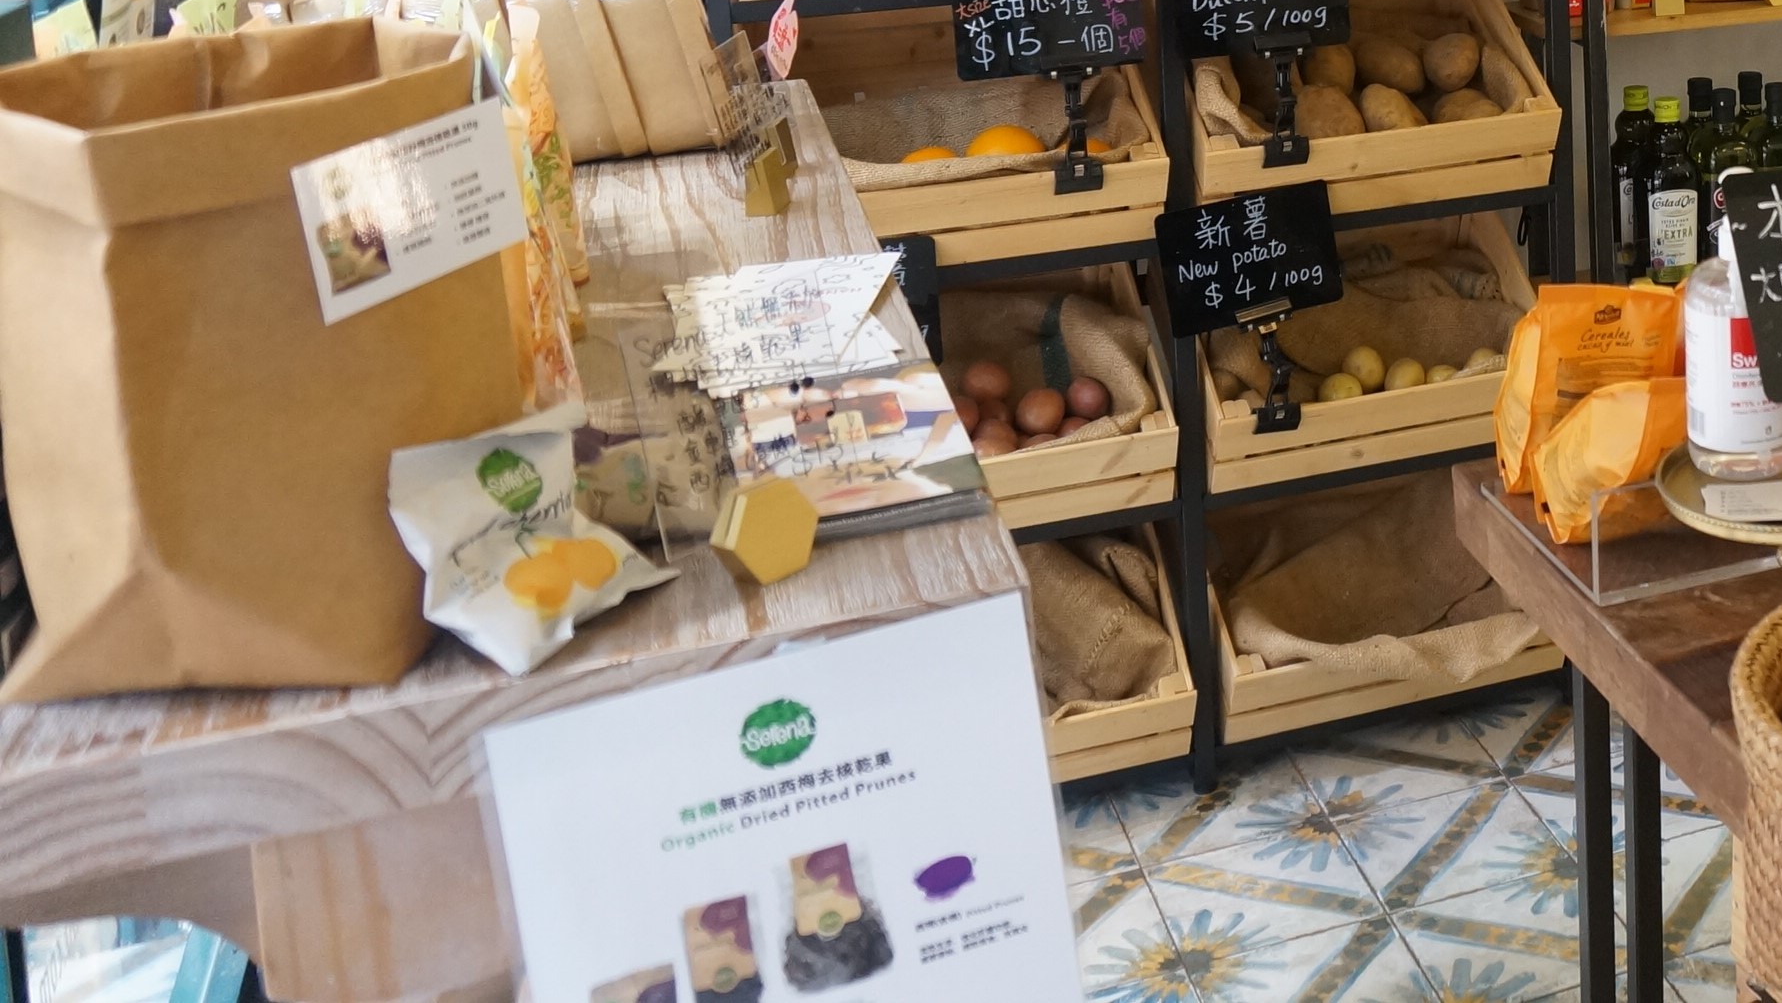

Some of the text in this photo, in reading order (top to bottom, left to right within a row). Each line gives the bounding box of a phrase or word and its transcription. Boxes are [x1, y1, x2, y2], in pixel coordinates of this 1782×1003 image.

[1194, 196, 1267, 249] 新薯
[1652, 197, 1673, 210] Costa
[1178, 239, 1286, 283] New potato
[1581, 326, 1630, 342] Cereales
[661, 770, 917, 852] Organic Dried Pitted Prunes
